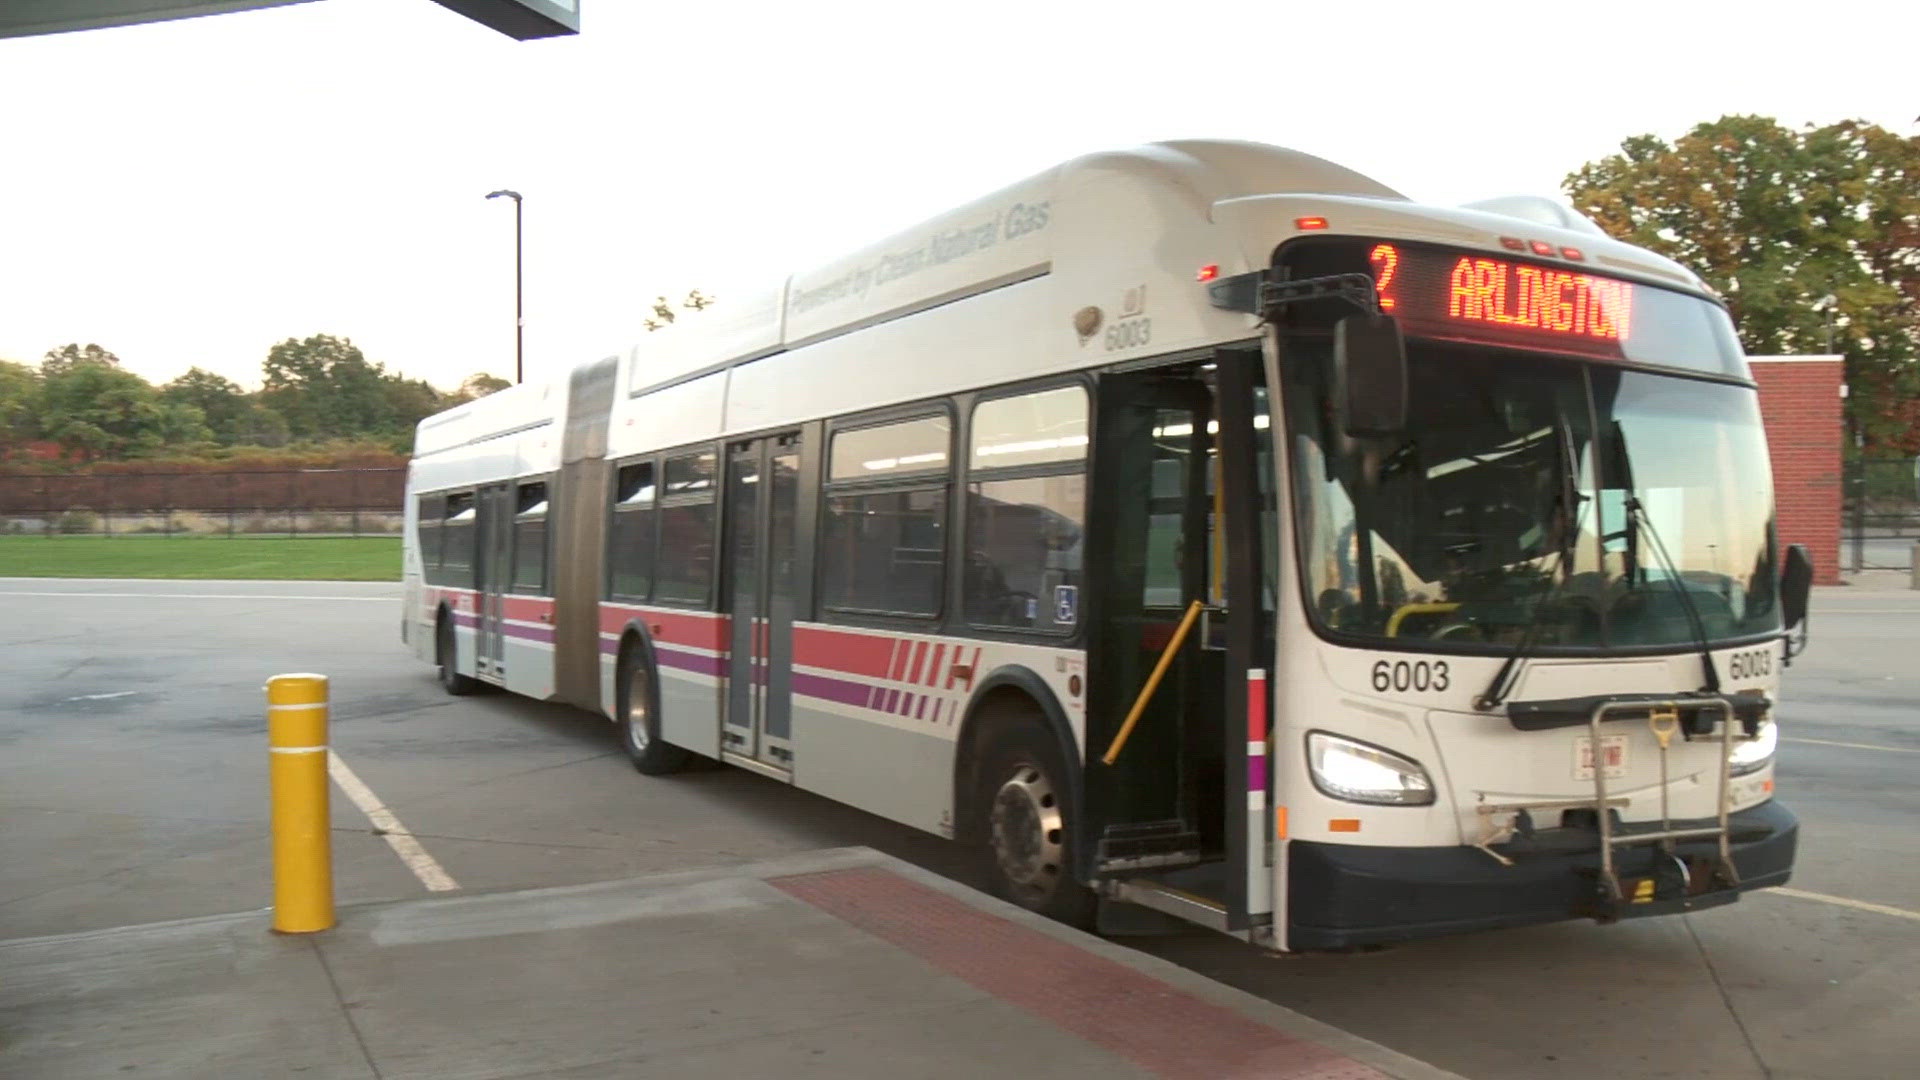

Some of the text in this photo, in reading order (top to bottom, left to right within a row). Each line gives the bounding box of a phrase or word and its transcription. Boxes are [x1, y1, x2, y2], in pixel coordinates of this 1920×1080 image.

[932, 211, 1000, 264] Natural
[1004, 201, 1050, 240] Gas
[1370, 243, 1634, 341] 2 ARLINGTON
[1105, 317, 1151, 351] 6003
[1372, 660, 1450, 692] 6003
[1730, 650, 1771, 680] 6003
